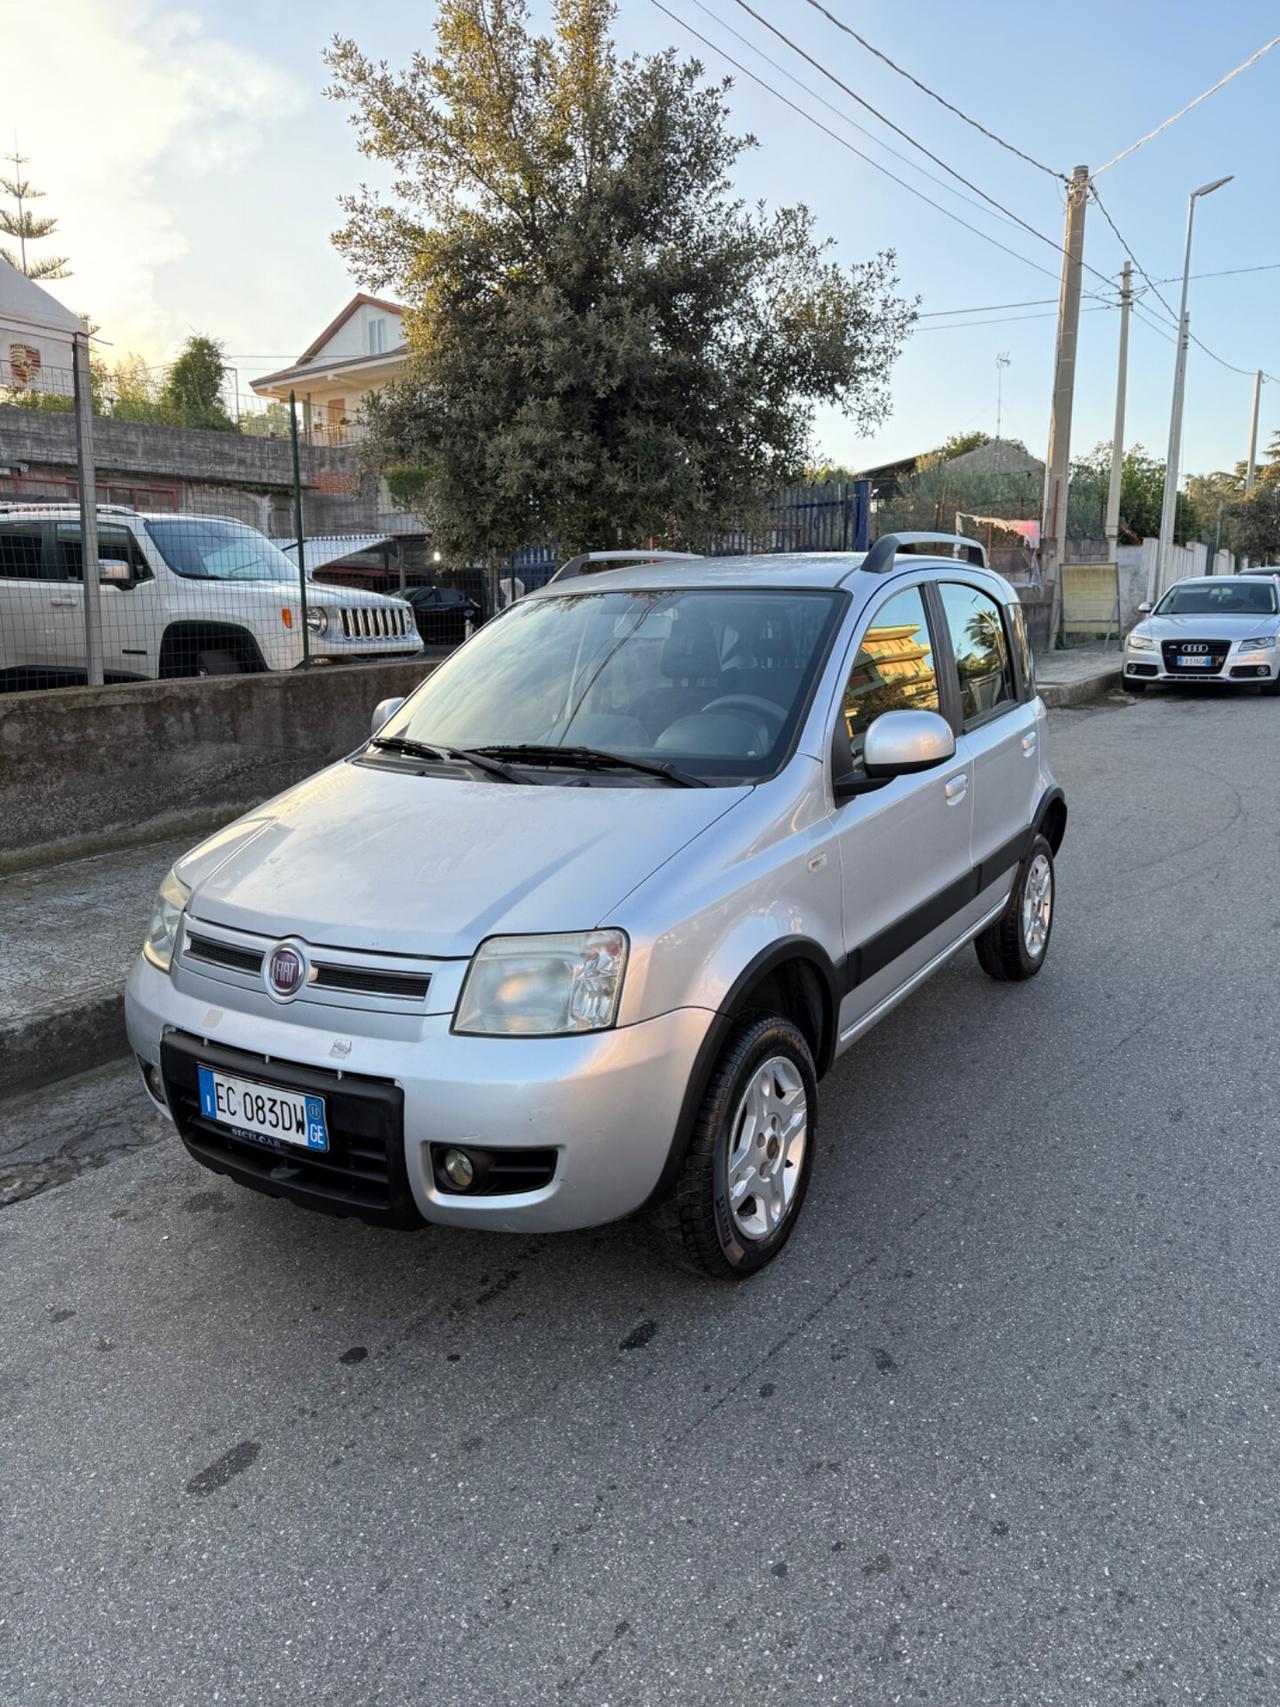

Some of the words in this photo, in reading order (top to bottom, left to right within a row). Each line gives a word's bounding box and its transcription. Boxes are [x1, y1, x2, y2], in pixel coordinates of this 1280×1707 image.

[275, 960, 297, 982] FIAT
[215, 1082, 238, 1116] EC
[243, 1091, 305, 1135] 083DW
[310, 1123, 324, 1144] GE
